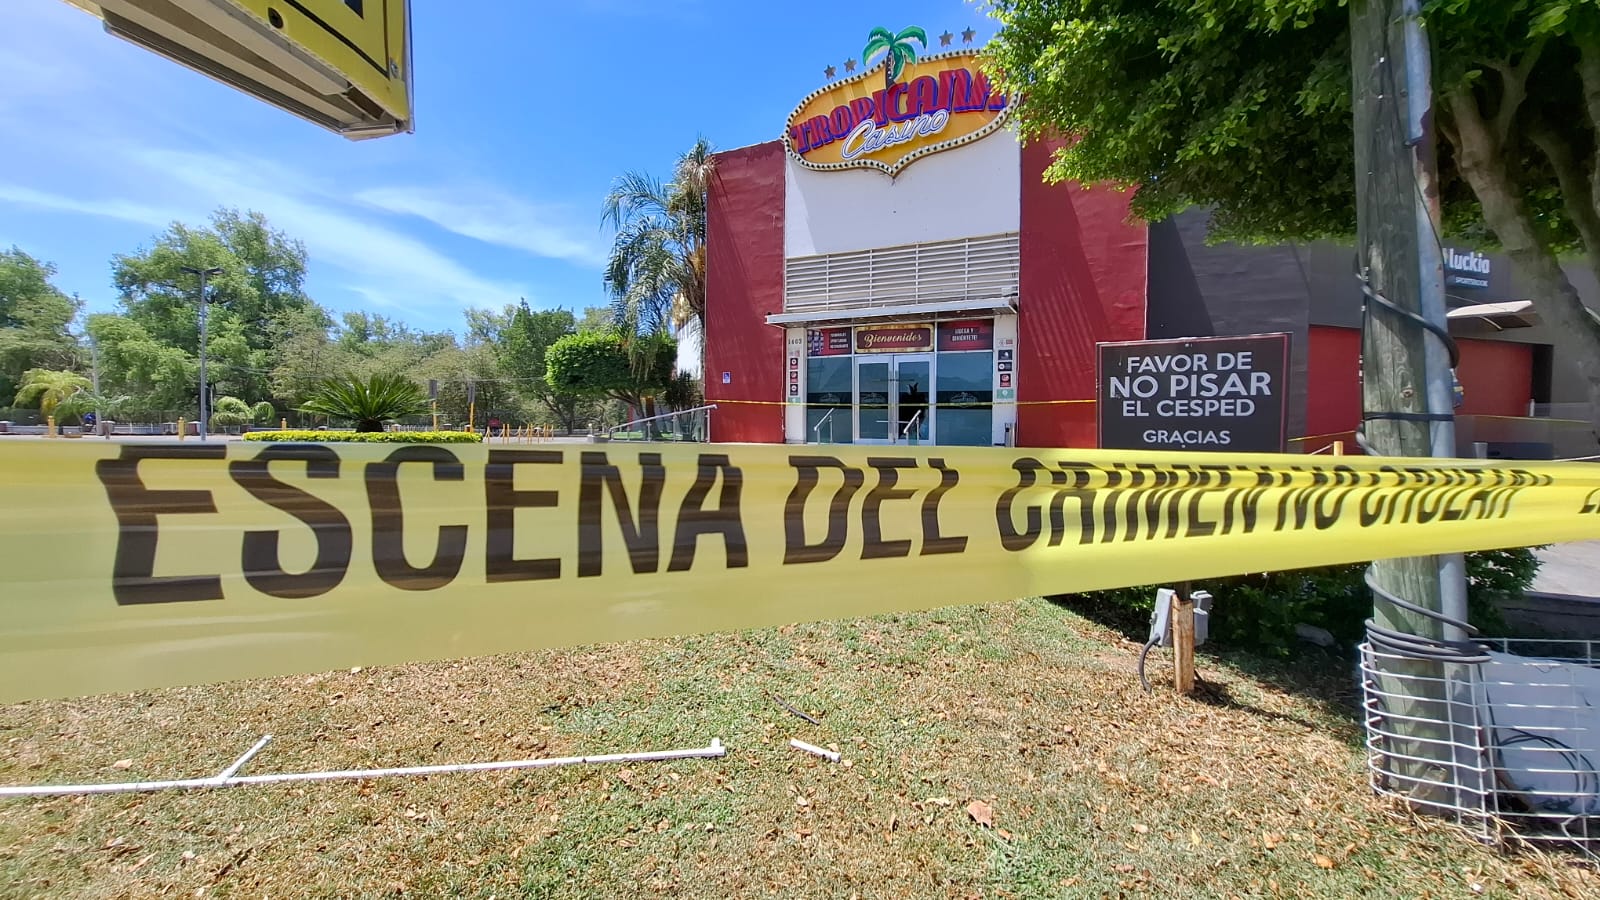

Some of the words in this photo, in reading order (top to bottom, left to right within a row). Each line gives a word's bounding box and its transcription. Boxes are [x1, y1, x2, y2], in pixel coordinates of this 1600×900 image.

[841, 108, 951, 161] Casino
[864, 331, 922, 348] Bienvenidos
[1127, 354, 1208, 373] FAVOR
[1216, 351, 1253, 370] DE
[1109, 375, 1159, 398] NO
[1169, 372, 1272, 397] PISAR
[1122, 400, 1150, 416] EL
[1156, 399, 1256, 417] CESPED
[1143, 430, 1231, 445] GRACIAS
[96, 444, 748, 606] ESCENA
[783, 455, 968, 565] DEL
[996, 457, 1292, 551] CRIMEN
[1273, 465, 1380, 530] NO
